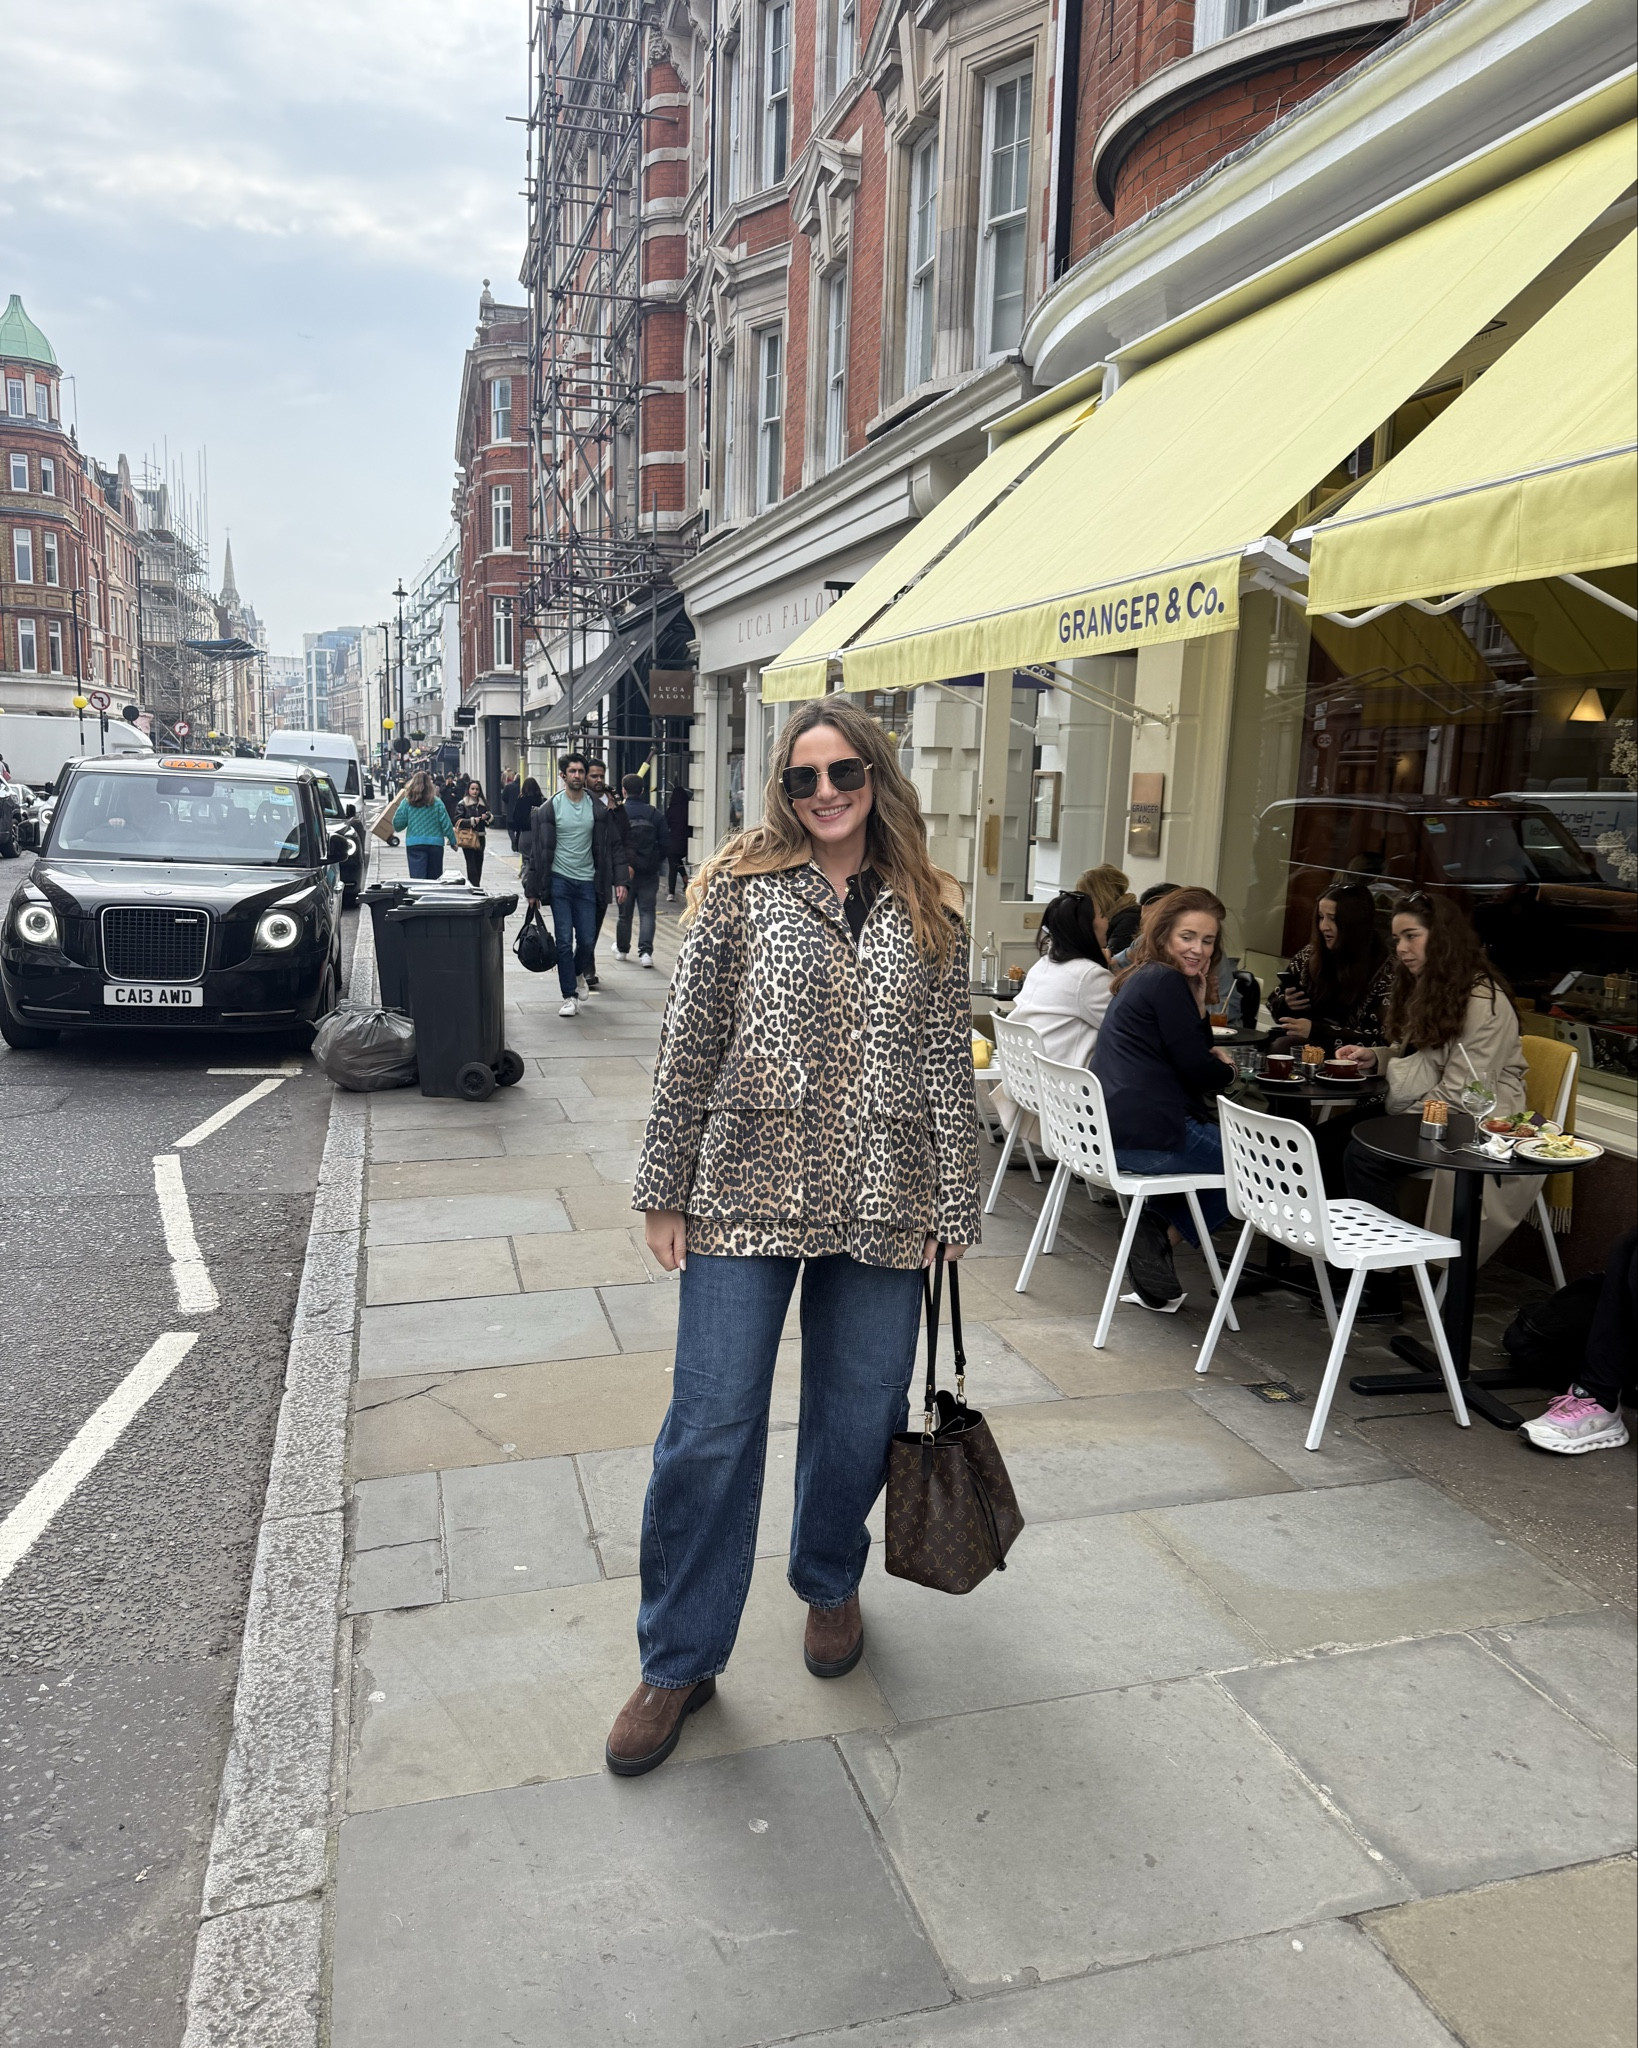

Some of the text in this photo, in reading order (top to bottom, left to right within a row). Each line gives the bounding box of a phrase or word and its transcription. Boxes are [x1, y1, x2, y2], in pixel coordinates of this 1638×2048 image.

[738, 589, 846, 643] LUCA FALO
[1059, 581, 1225, 643] GRANGER & Co.
[169, 760, 210, 769] TAXI
[1131, 804, 1159, 814] GRANGER
[115, 988, 192, 1005] CA13 AWD
